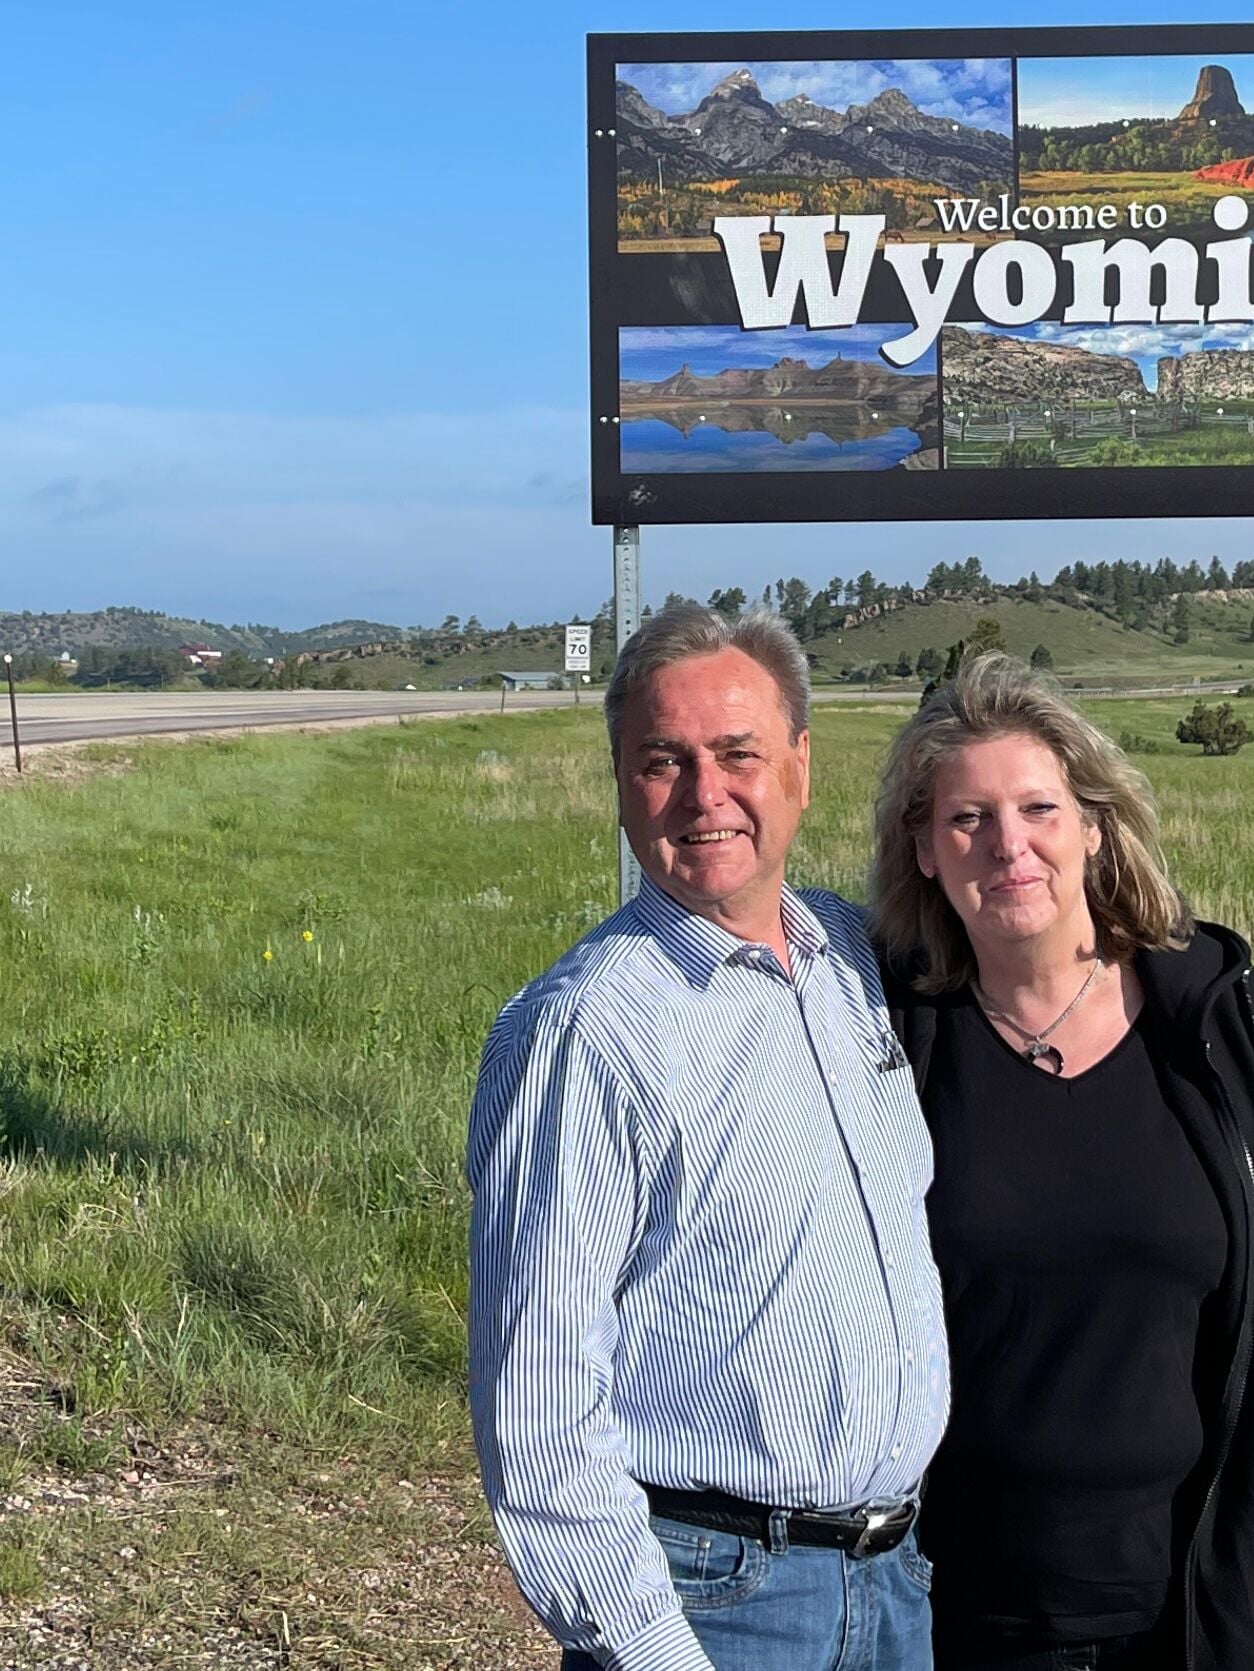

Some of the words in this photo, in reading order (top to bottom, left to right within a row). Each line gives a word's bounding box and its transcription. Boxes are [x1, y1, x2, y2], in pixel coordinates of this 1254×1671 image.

[934, 194, 1118, 232] Welcome
[1127, 200, 1168, 230] to
[568, 644, 587, 655] 70
